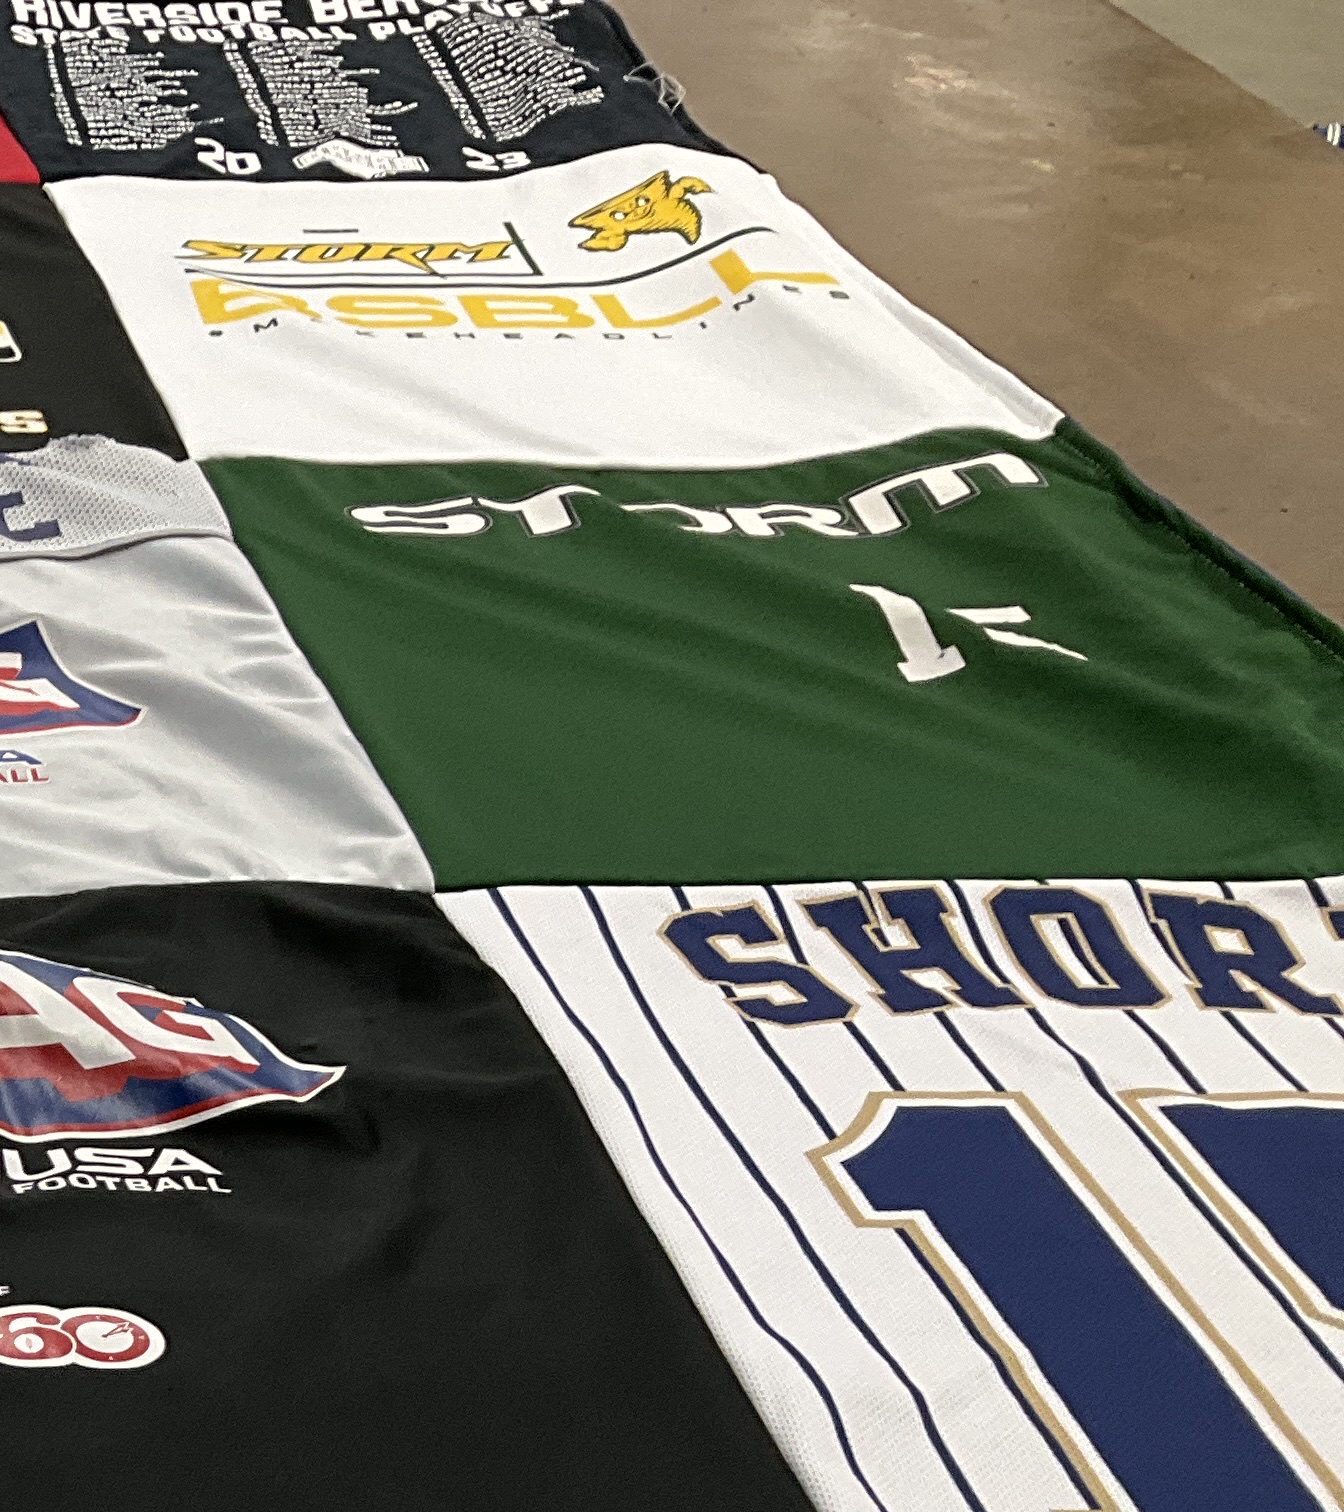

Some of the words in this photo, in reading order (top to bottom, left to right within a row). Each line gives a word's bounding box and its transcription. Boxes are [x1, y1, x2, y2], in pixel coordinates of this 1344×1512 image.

[11, 0, 289, 28] RIVERSIDE
[194, 136, 262, 174] 20
[461, 147, 531, 170] 23
[174, 238, 526, 279] STORM
[658, 880, 1344, 1029] SHOR
[2, 1147, 224, 1180] USA
[12, 1175, 232, 1195] FOOTBALL
